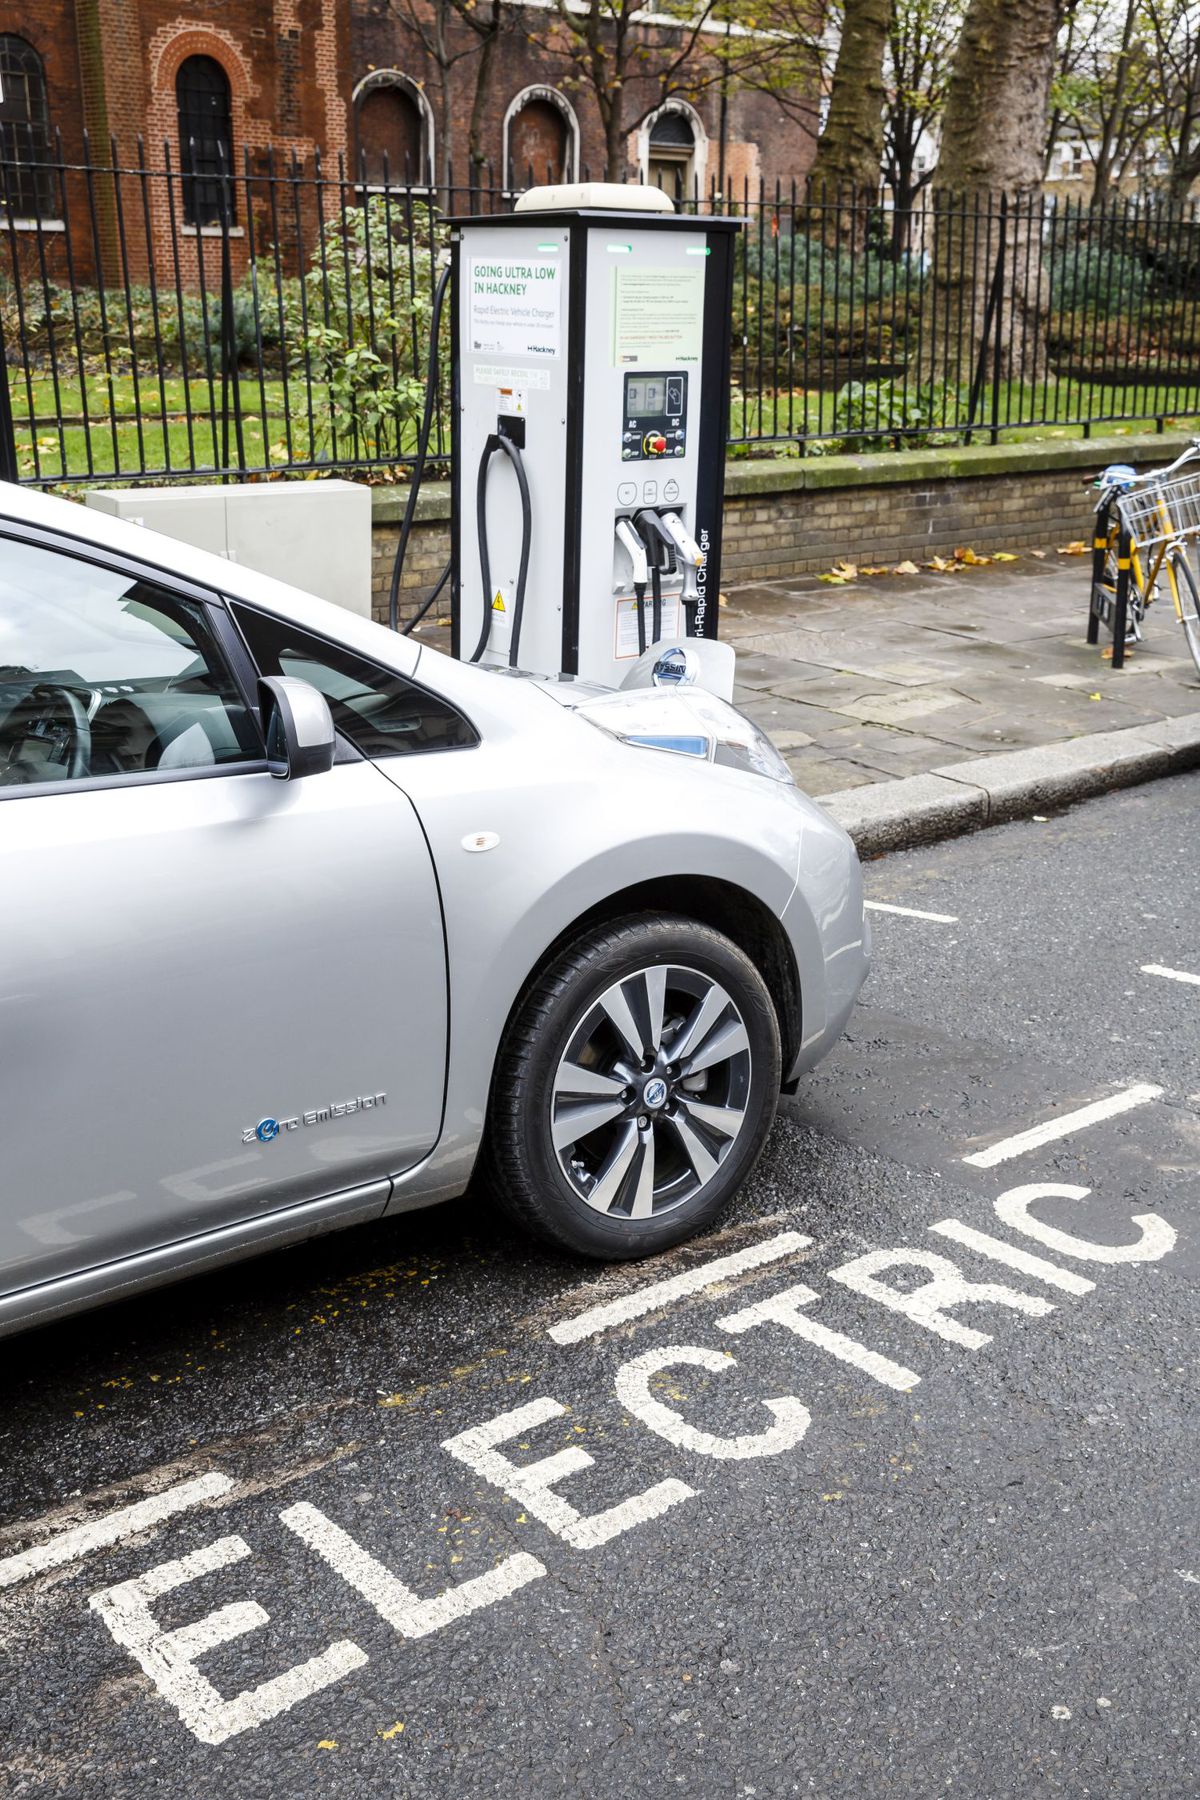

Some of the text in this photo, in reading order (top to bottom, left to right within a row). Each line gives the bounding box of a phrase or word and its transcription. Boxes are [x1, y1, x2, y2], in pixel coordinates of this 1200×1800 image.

[474, 266, 556, 279] GOING ULTRA LOW
[474, 282, 527, 296] IN HACKNEY
[534, 345, 556, 355] Hackney
[628, 420, 637, 428] AC
[671, 418, 680, 427] DC
[694, 586, 708, 637] ri-Rapid
[302, 1092, 388, 1126] Emission
[88, 1182, 1177, 1745] ELECTRIC
